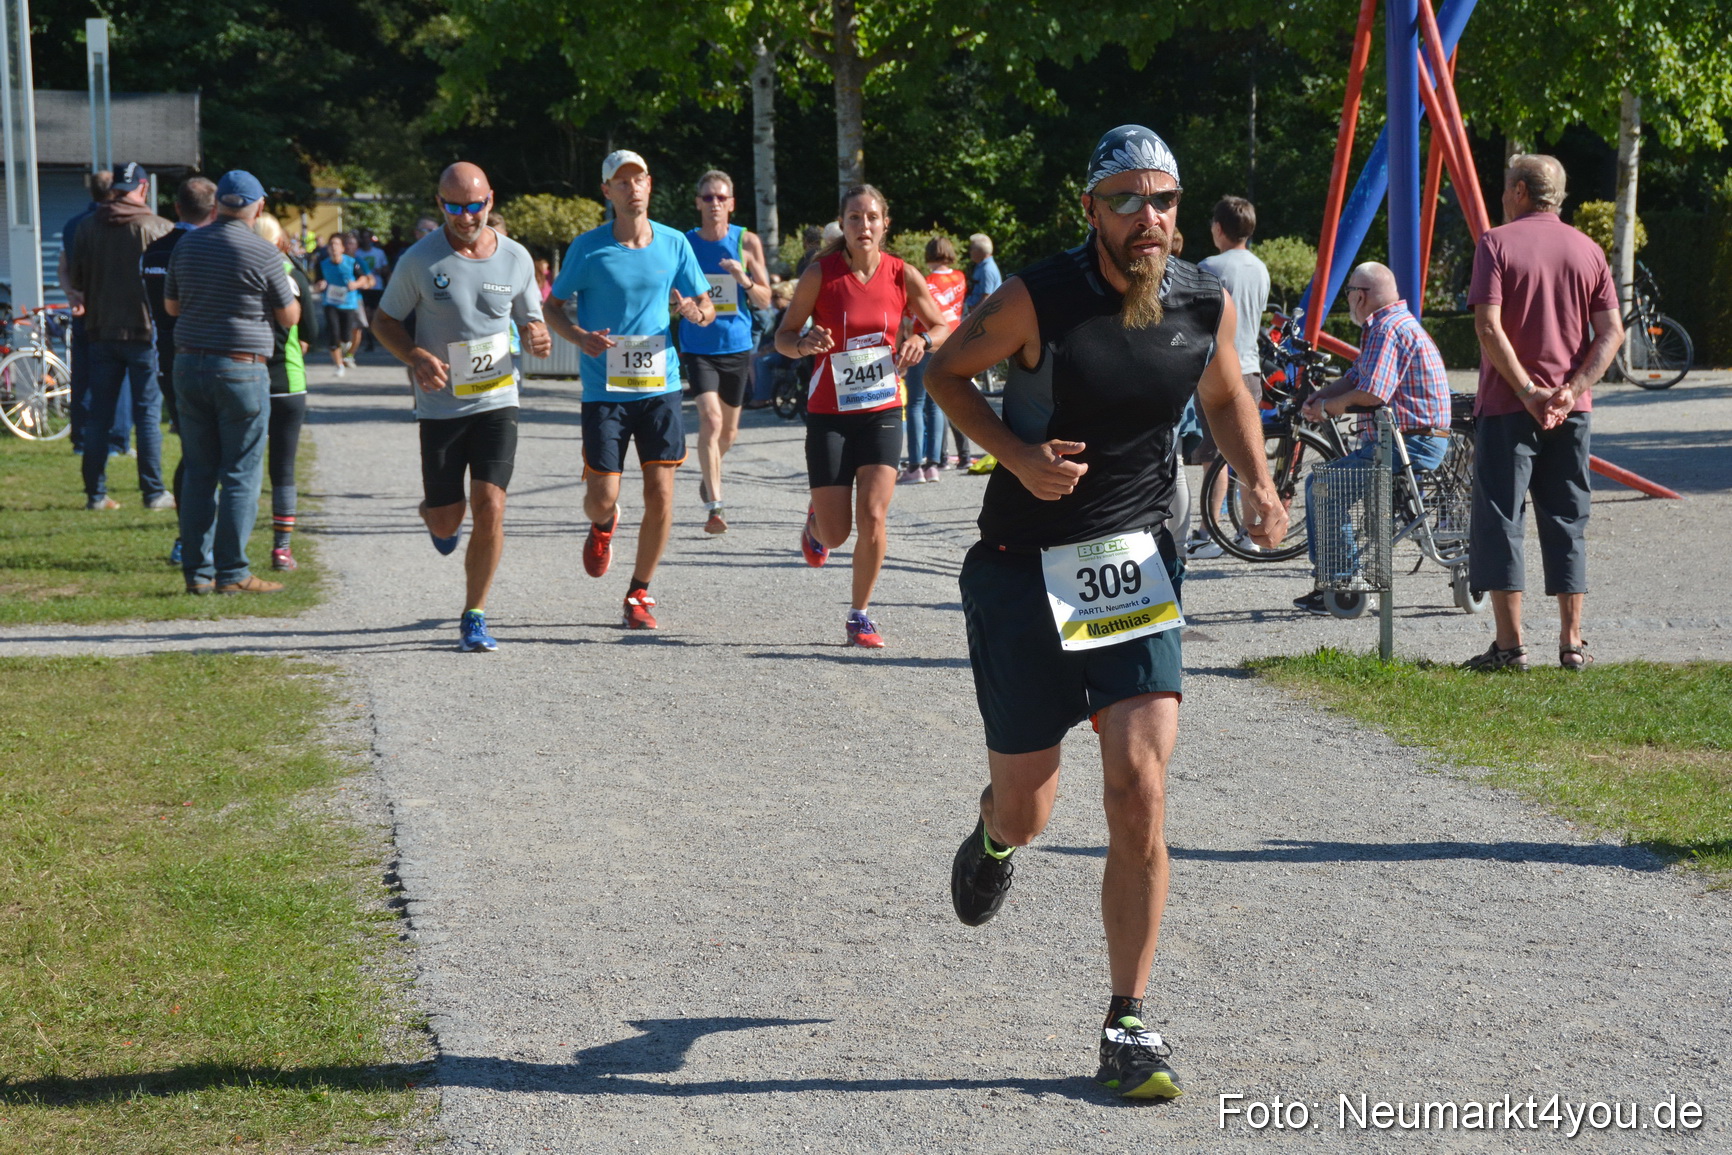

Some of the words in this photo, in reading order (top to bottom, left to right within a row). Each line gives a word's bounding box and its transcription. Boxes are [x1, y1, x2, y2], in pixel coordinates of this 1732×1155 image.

[483, 283, 512, 293] BOCK
[471, 354, 494, 374] 22
[622, 351, 653, 369] 133
[850, 353, 876, 363] BOCK
[627, 378, 648, 386] Oliver
[843, 362, 884, 386] 2441
[471, 381, 499, 392] Thomas
[845, 390, 891, 404] Anne-Sophie
[1077, 539, 1130, 558] BOCK
[1076, 560, 1142, 602] 309
[1078, 607, 1105, 616] PARTL
[1105, 600, 1140, 612] Neumarkt
[1087, 613, 1151, 636] Matthias
